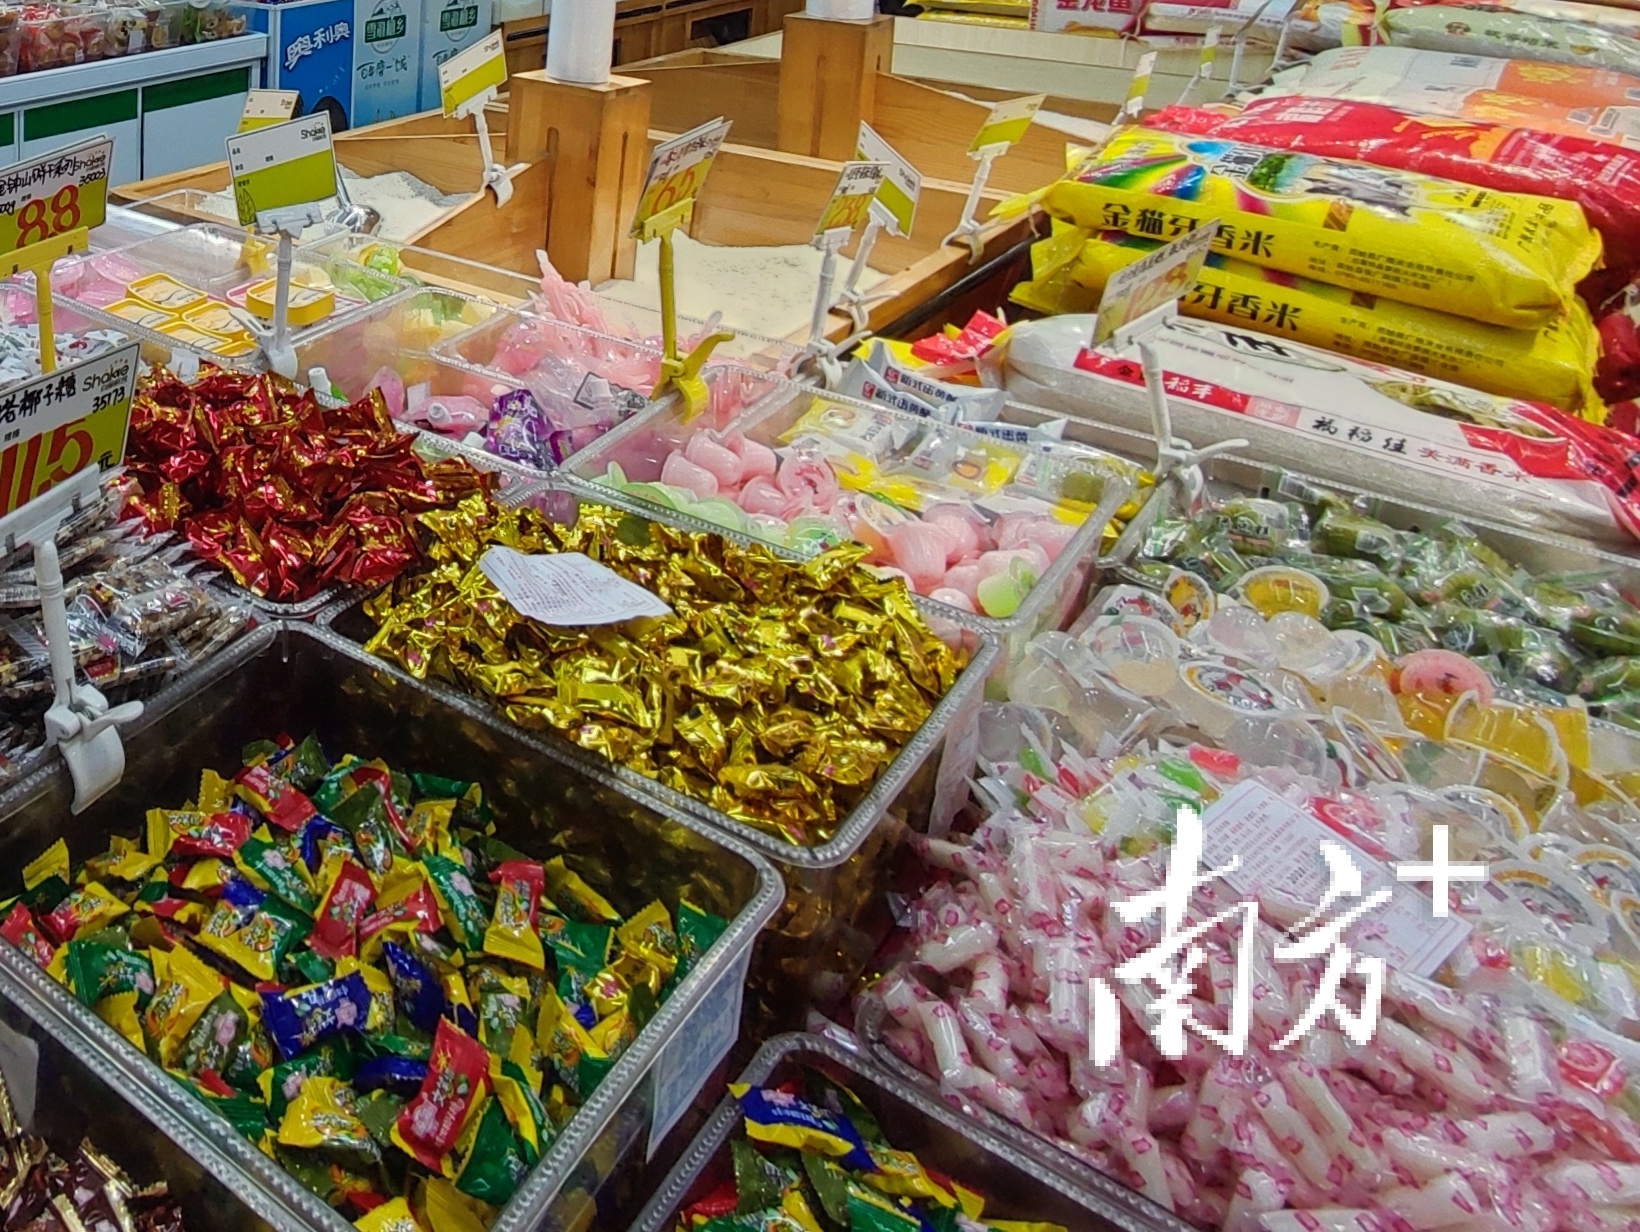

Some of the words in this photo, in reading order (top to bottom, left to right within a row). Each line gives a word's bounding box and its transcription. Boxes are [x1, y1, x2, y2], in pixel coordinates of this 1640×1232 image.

[284, 22, 351, 71] 奥利奥
[1102, 202, 1275, 258] 金猫牙香米
[1189, 280, 1302, 332] 牙香米
[91, 386, 125, 414] 35173
